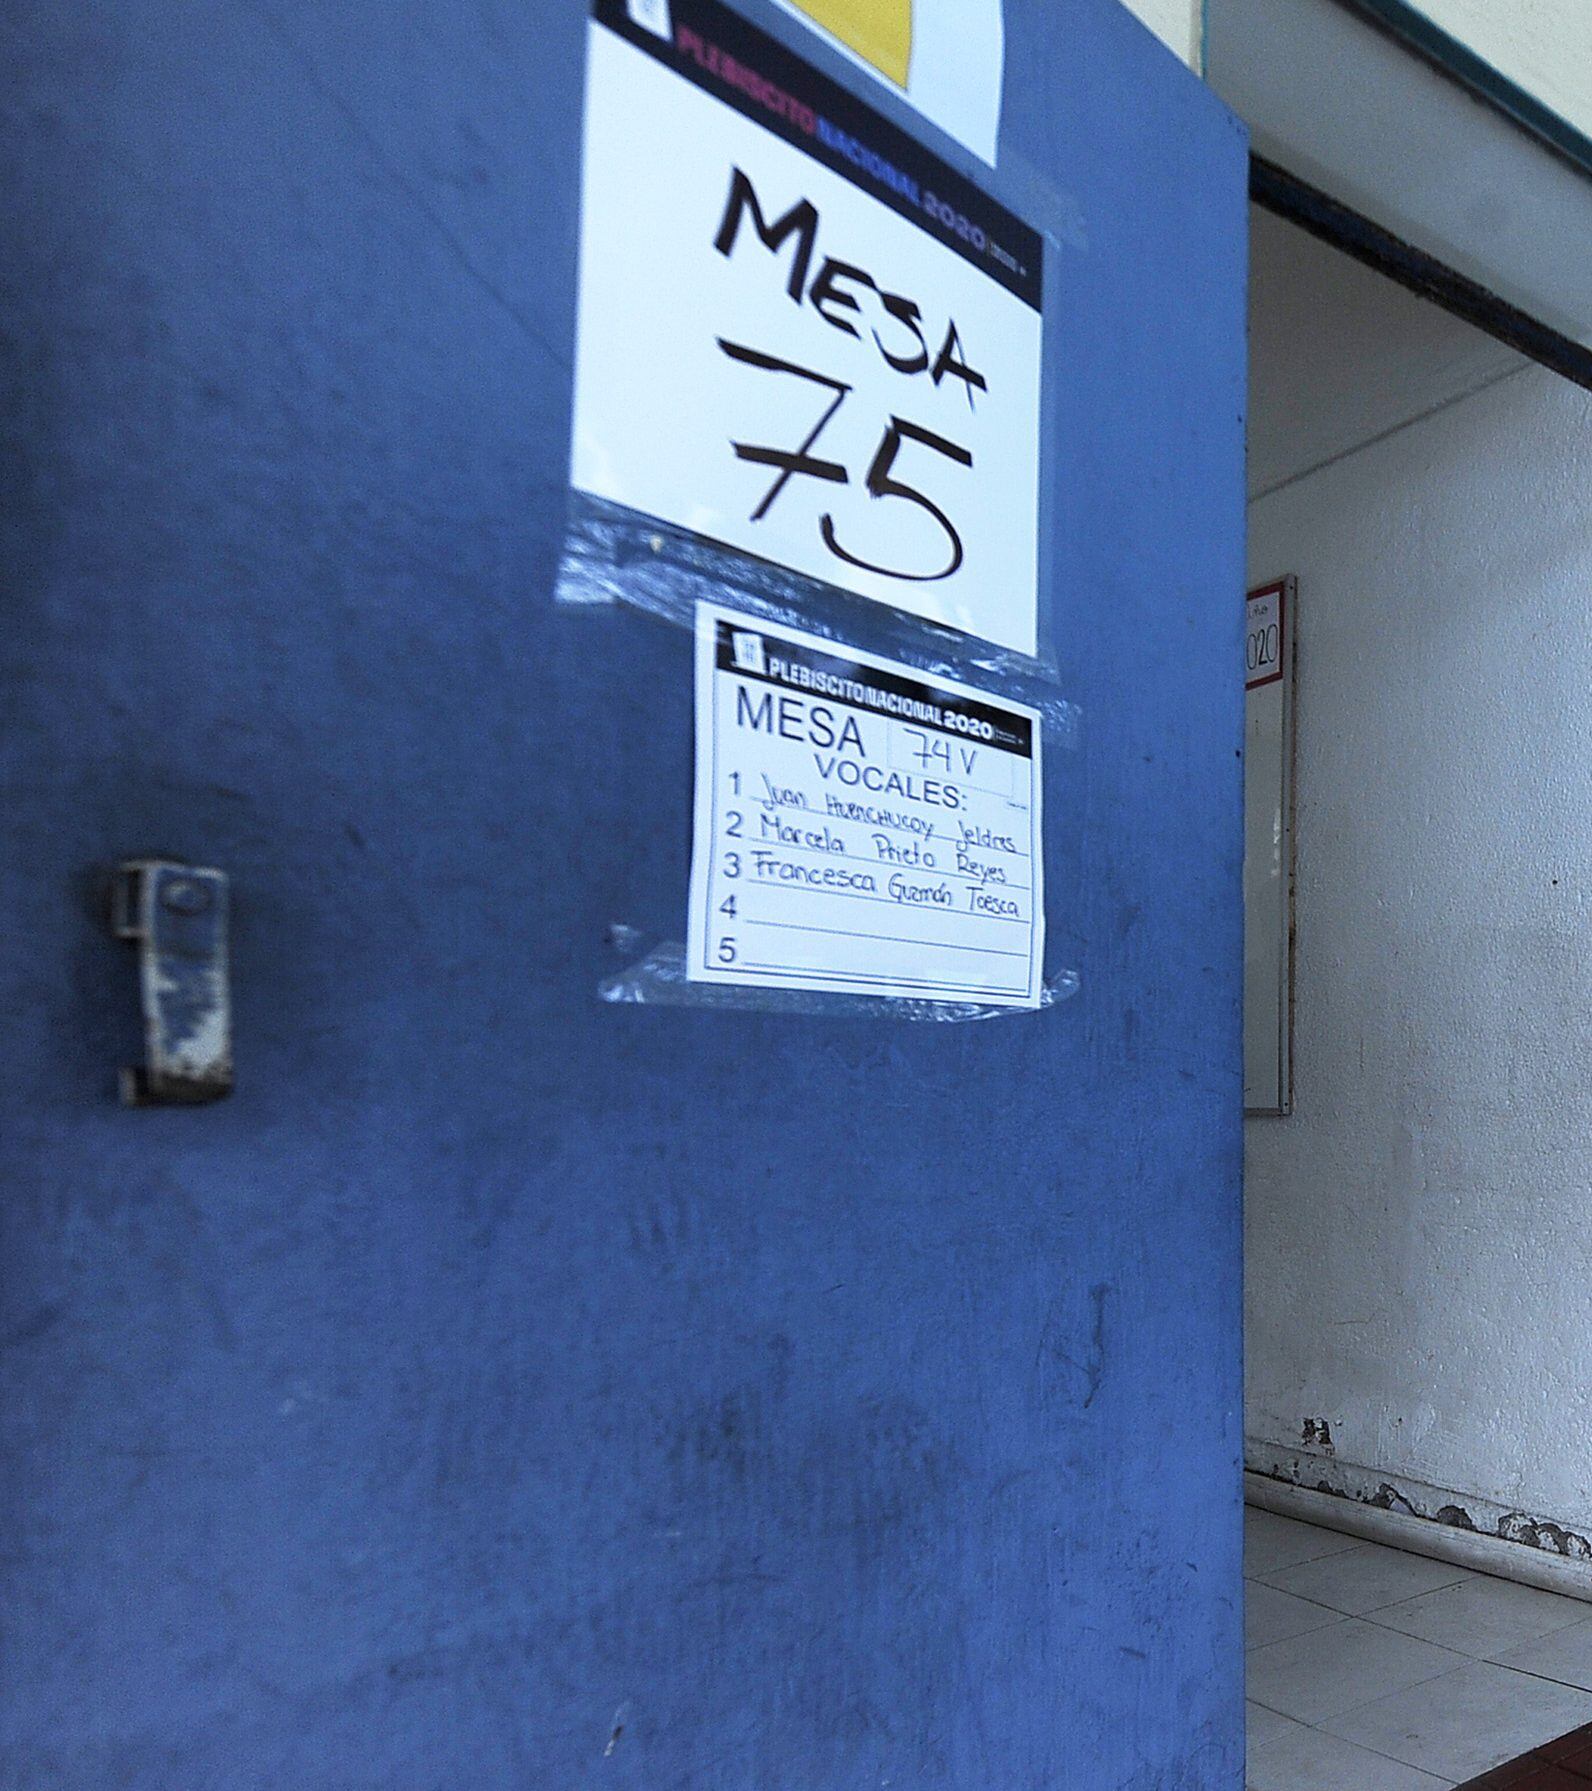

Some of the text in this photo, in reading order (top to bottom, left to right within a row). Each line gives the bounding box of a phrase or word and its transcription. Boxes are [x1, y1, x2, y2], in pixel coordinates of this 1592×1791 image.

[920, 188, 986, 252] 2020
[716, 335, 972, 581] 75
[737, 685, 865, 757] MESA
[943, 709, 993, 740] 2020
[729, 771, 741, 795] 1
[760, 772, 807, 811] Juan
[813, 753, 967, 811] VOCALES:
[723, 852, 741, 878] 3
[750, 850, 878, 892] Francesca
[726, 810, 1006, 885] 2 Marcela Prieto Reyes
[719, 895, 736, 918] 4
[718, 937, 735, 963] 5
